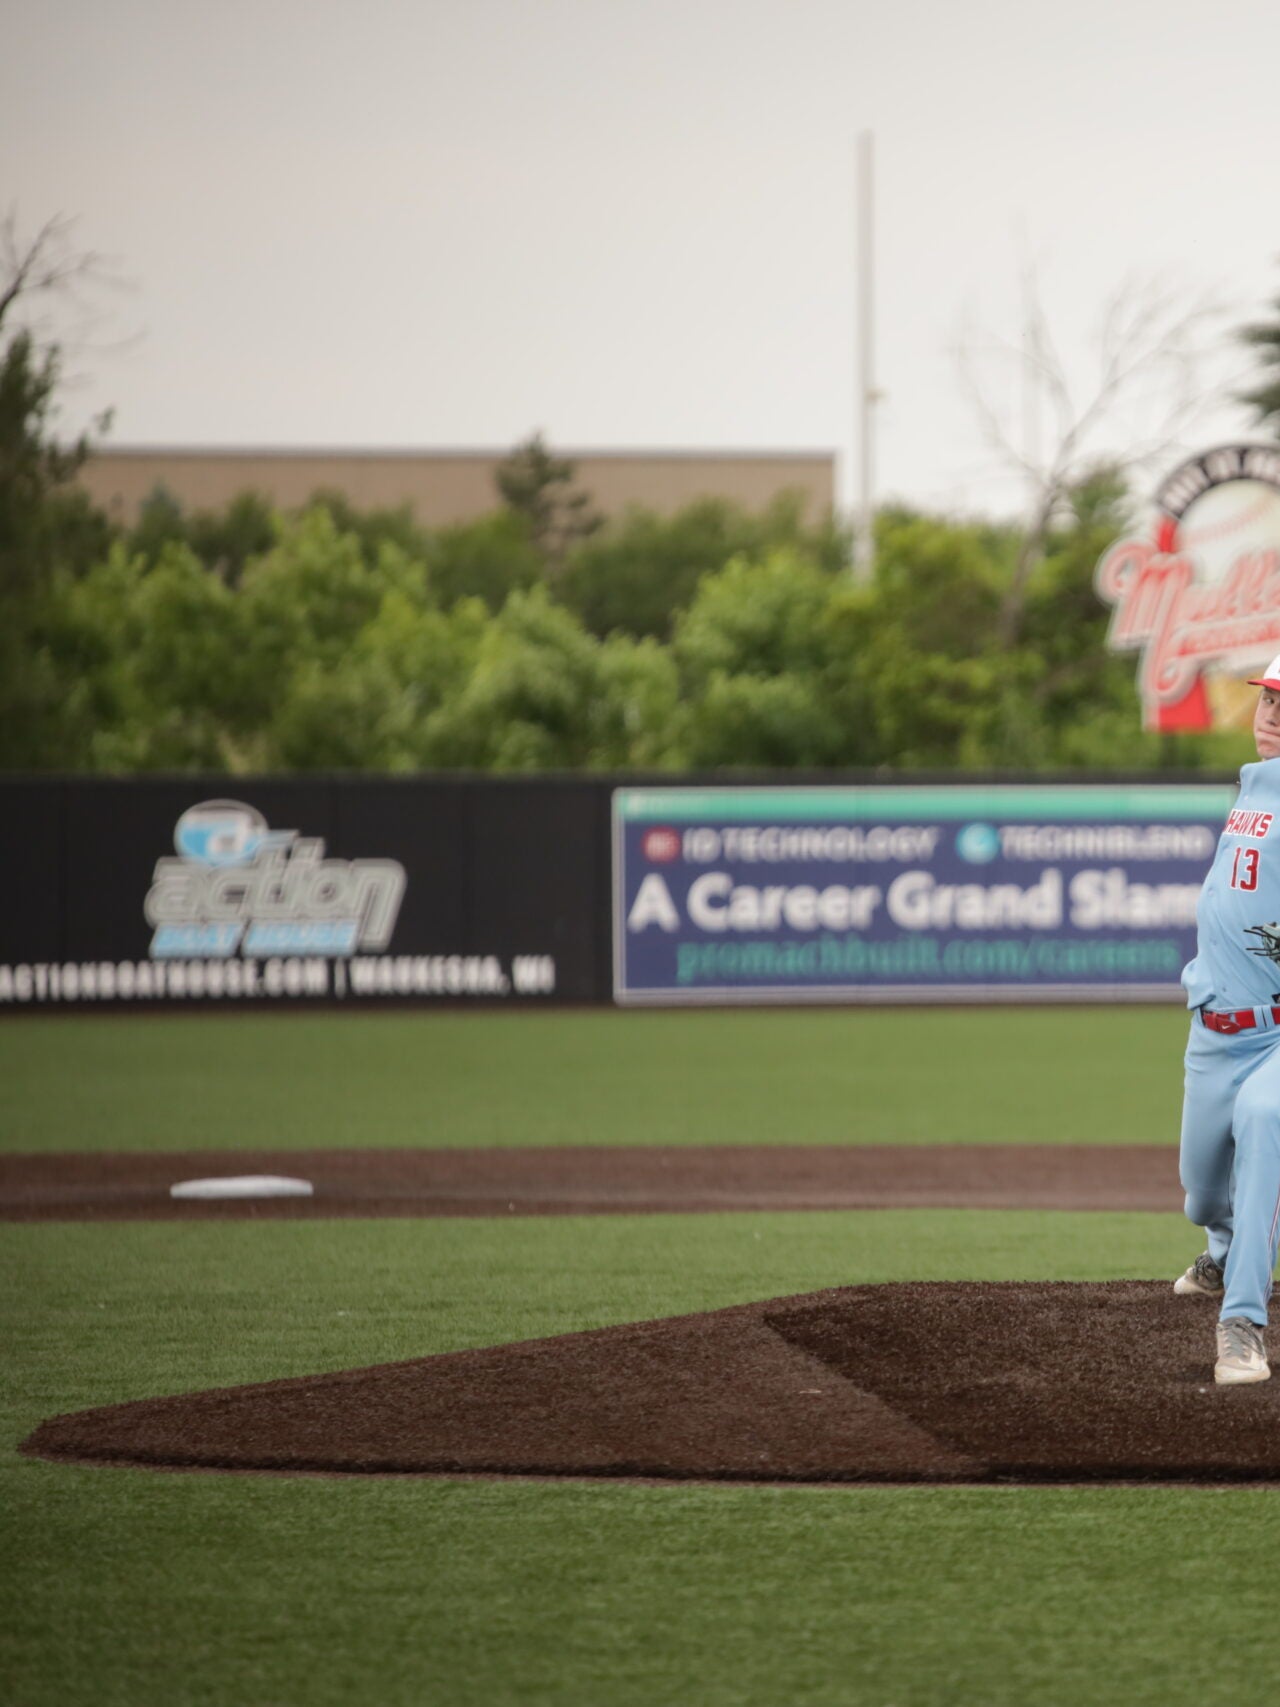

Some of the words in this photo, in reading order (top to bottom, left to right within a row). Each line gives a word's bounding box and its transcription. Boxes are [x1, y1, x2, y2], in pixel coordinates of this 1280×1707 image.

[721, 826, 939, 863] TECHNOLOGY
[1230, 846, 1259, 892] 13
[144, 836, 407, 952] action
[627, 873, 681, 932] A
[687, 871, 881, 932] Career
[887, 867, 1063, 931] Grand
